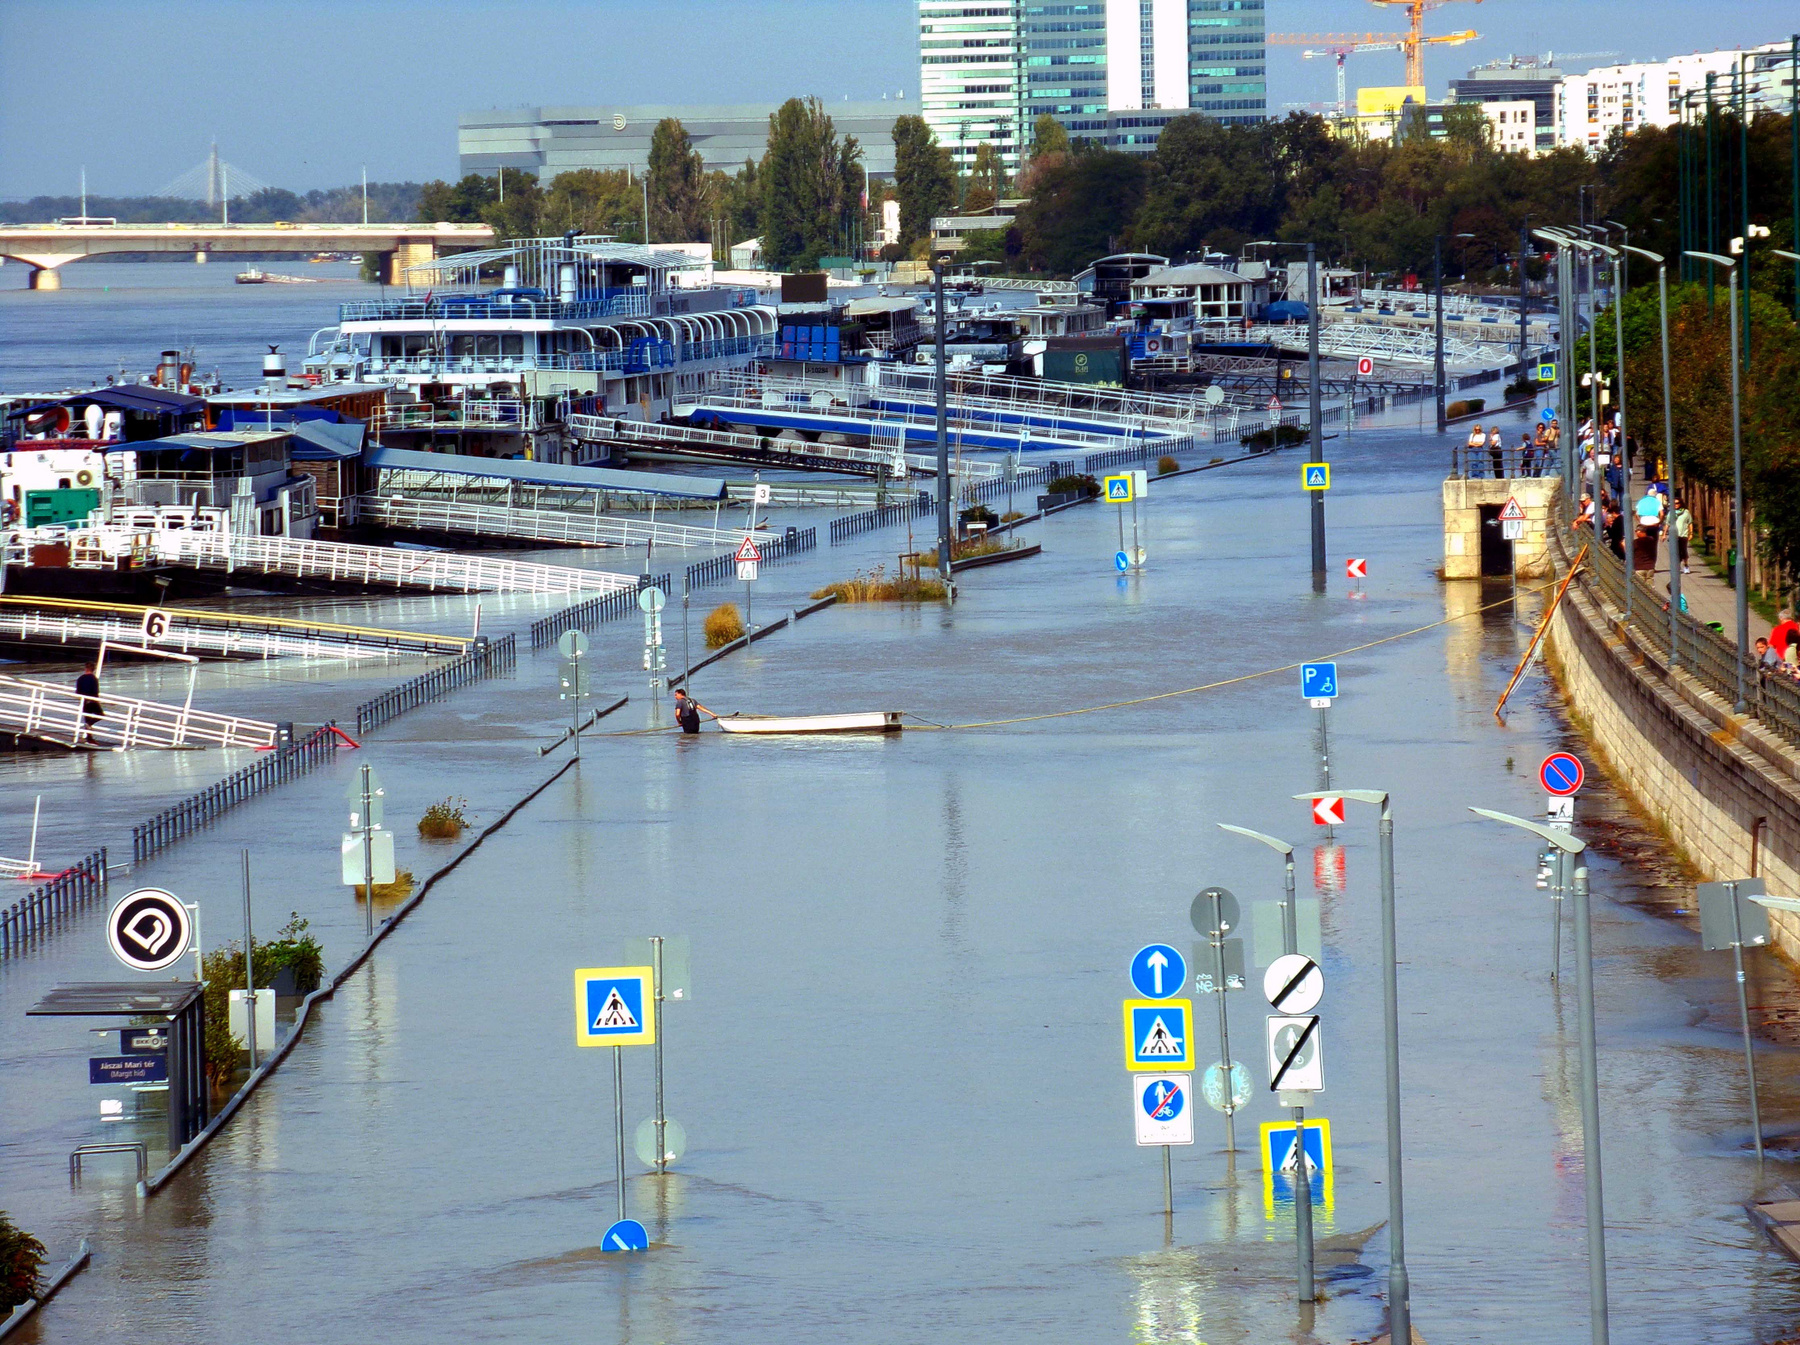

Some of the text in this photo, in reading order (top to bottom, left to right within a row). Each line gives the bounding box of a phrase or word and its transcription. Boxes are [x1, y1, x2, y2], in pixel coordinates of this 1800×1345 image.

[897, 462, 904, 473] 2
[760, 489, 767, 498] 3
[146, 613, 166, 638] 6
[1305, 667, 1317, 684] P
[100, 1060, 156, 1070] Jászai Mari tér
[111, 1070, 133, 1079] (Margit
